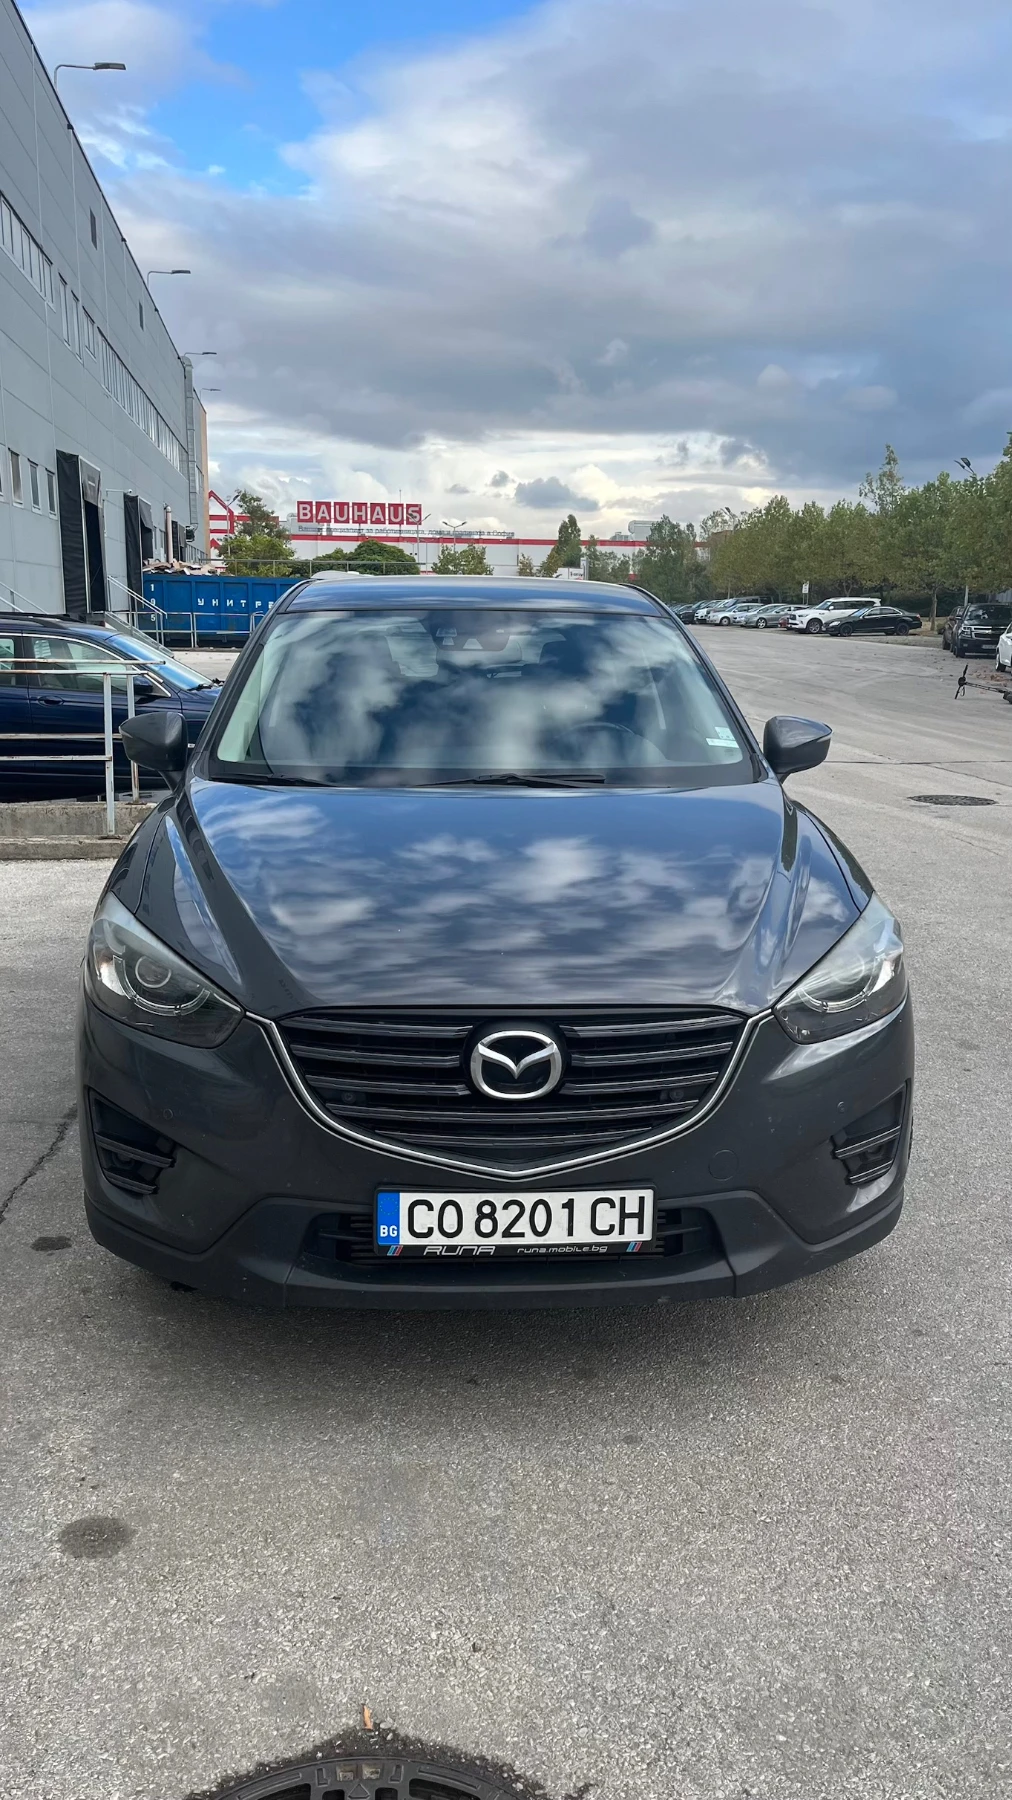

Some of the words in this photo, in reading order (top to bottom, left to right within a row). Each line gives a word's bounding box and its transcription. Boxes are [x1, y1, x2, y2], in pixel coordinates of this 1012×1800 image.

[298, 502, 421, 524] BAUHAUS
[407, 1198, 464, 1239] CO
[474, 1197, 575, 1239] 8201
[590, 1195, 646, 1237] CH
[379, 1225, 398, 1238] BG
[423, 1245, 496, 1256] RUNA
[517, 1244, 608, 1254] runa.mobile.bg
